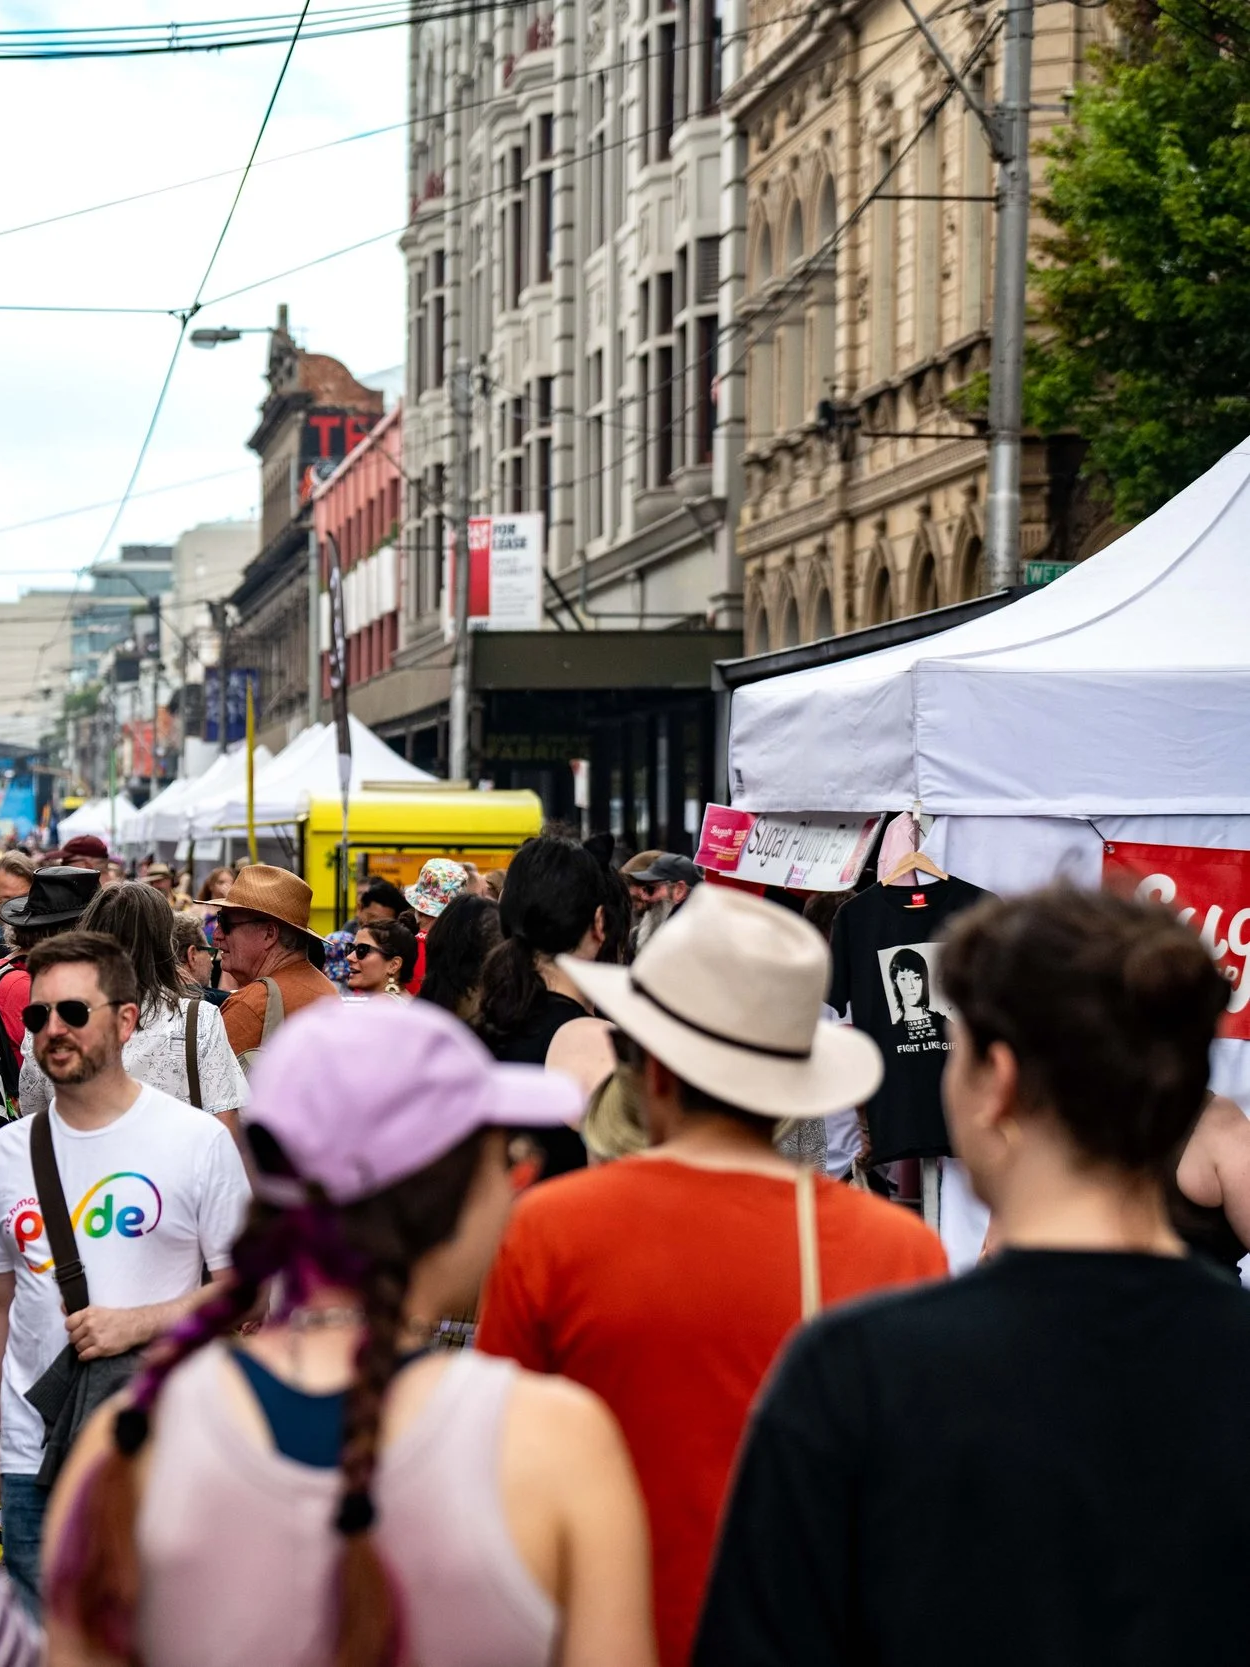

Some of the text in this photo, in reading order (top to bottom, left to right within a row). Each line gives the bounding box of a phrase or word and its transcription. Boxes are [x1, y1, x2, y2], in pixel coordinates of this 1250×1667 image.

[493, 523, 516, 535] FOR
[493, 536, 527, 550] LEASE
[747, 815, 792, 867] Sugar
[786, 819, 832, 874] Plump
[897, 1044, 920, 1053] FIGHT
[6, 1197, 41, 1235] richmo
[14, 1193, 146, 1253] pde
